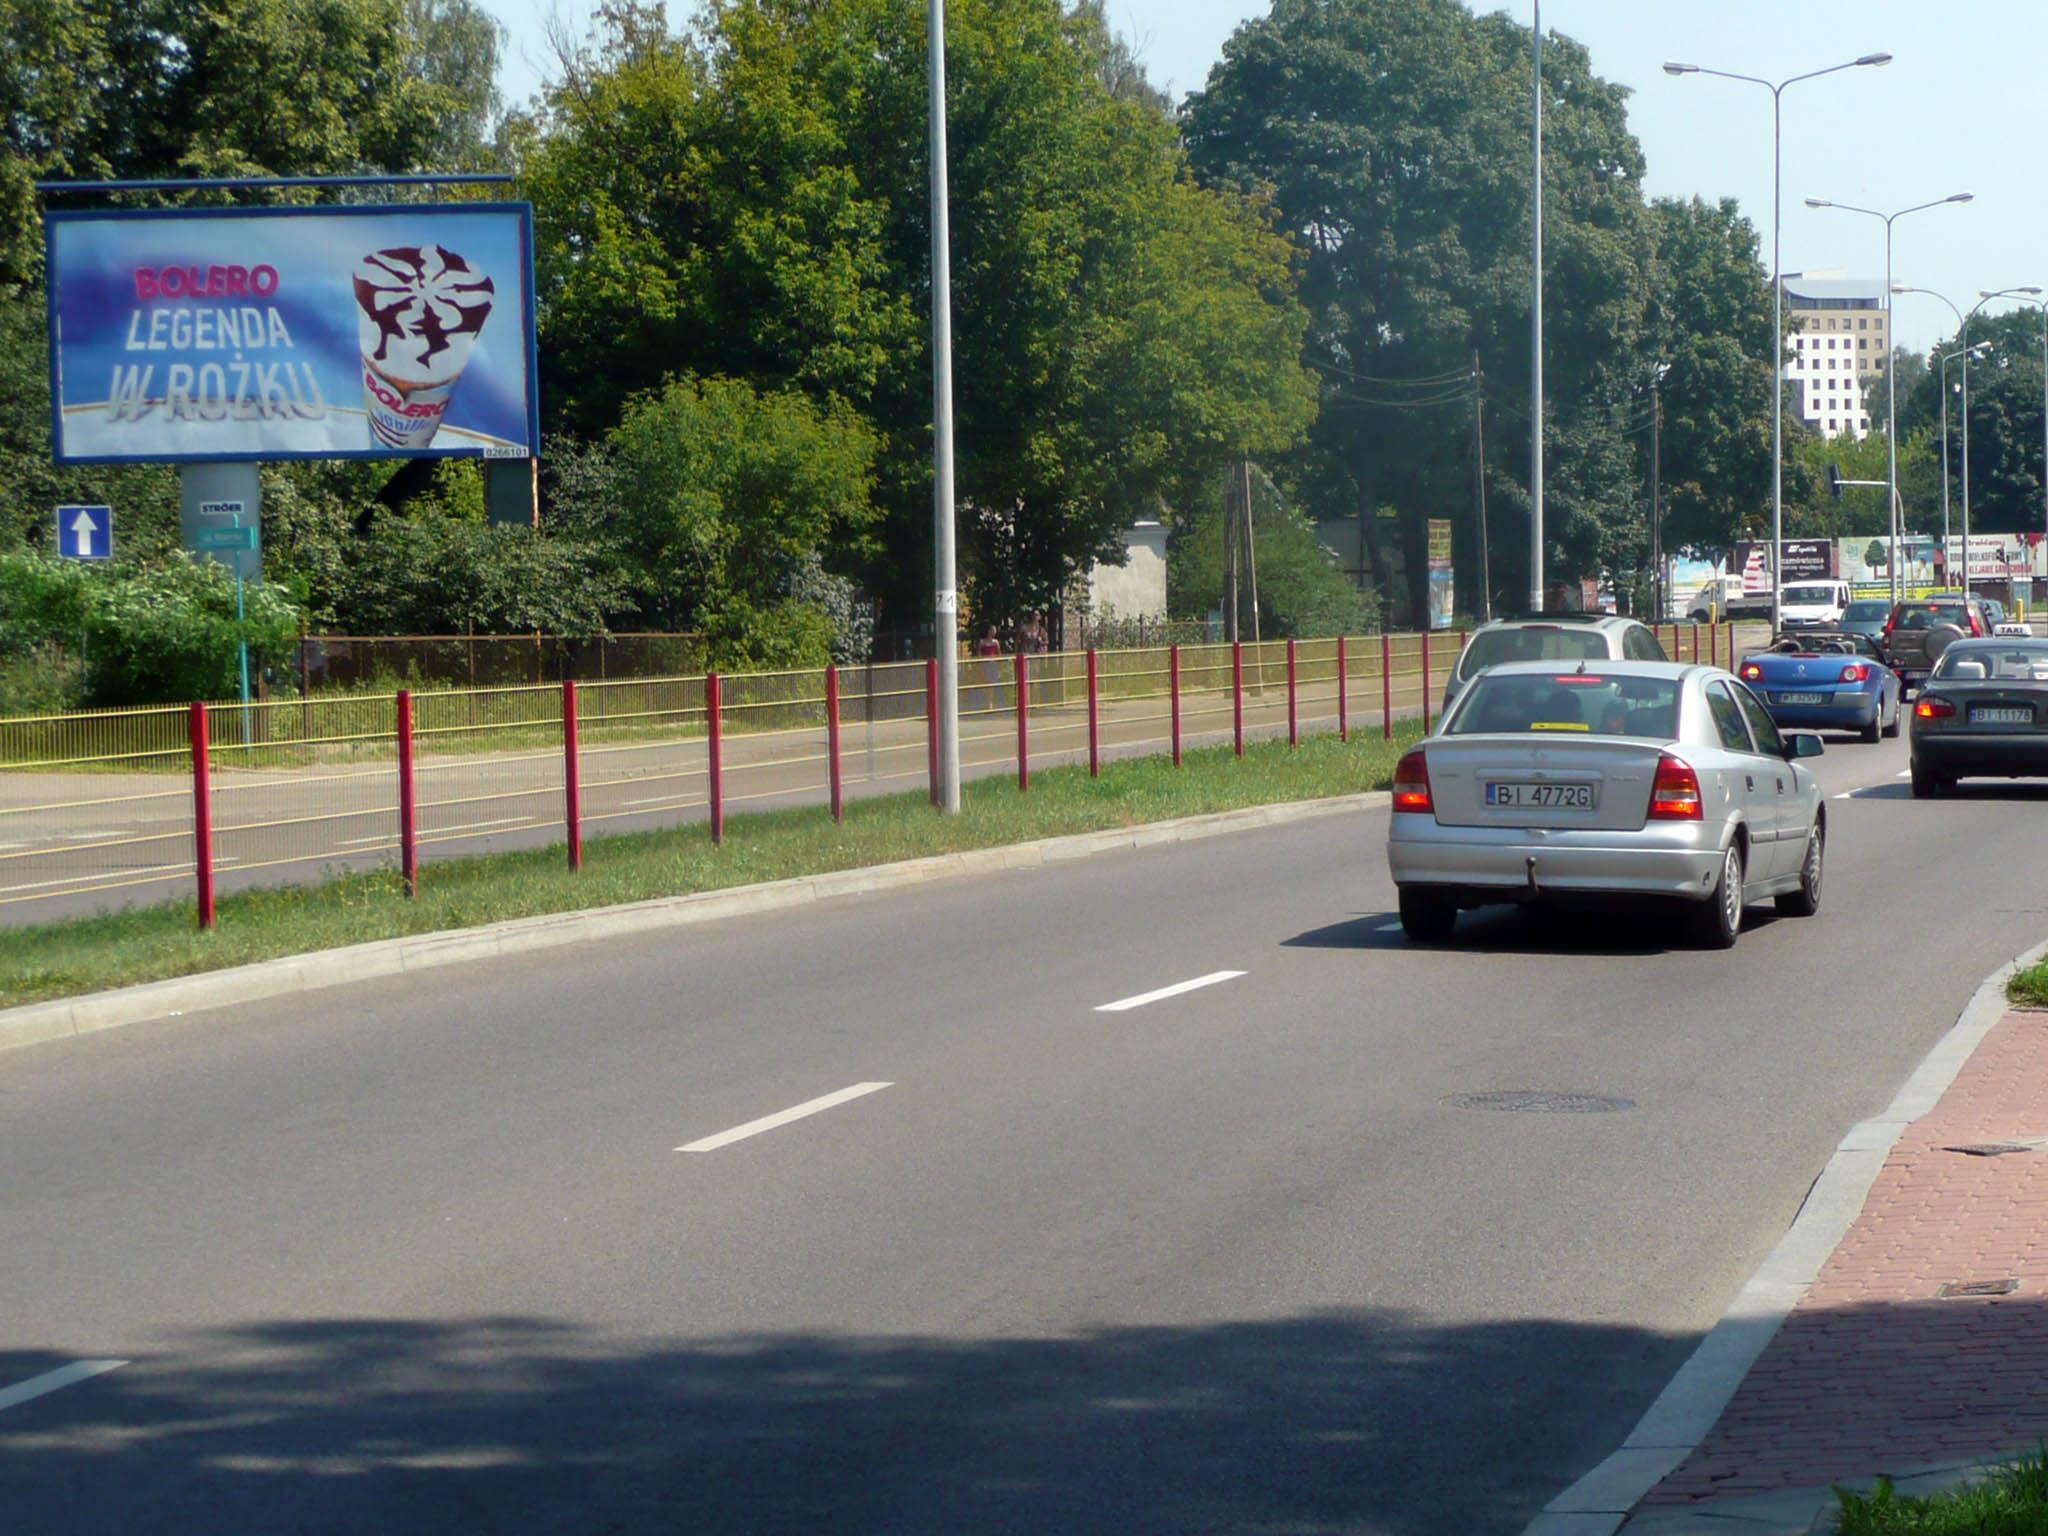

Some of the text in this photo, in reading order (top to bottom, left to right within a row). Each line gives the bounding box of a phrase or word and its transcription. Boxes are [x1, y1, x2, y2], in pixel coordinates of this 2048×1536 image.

[134, 264, 279, 299] BOLERO
[125, 307, 294, 350] LEGENDA
[106, 351, 326, 423] W ROŻKU
[485, 449, 528, 457] 0266101
[202, 503, 242, 513] STRÖER
[2000, 626, 2024, 634] TAXI
[1498, 786, 1589, 806] BI 4772G
